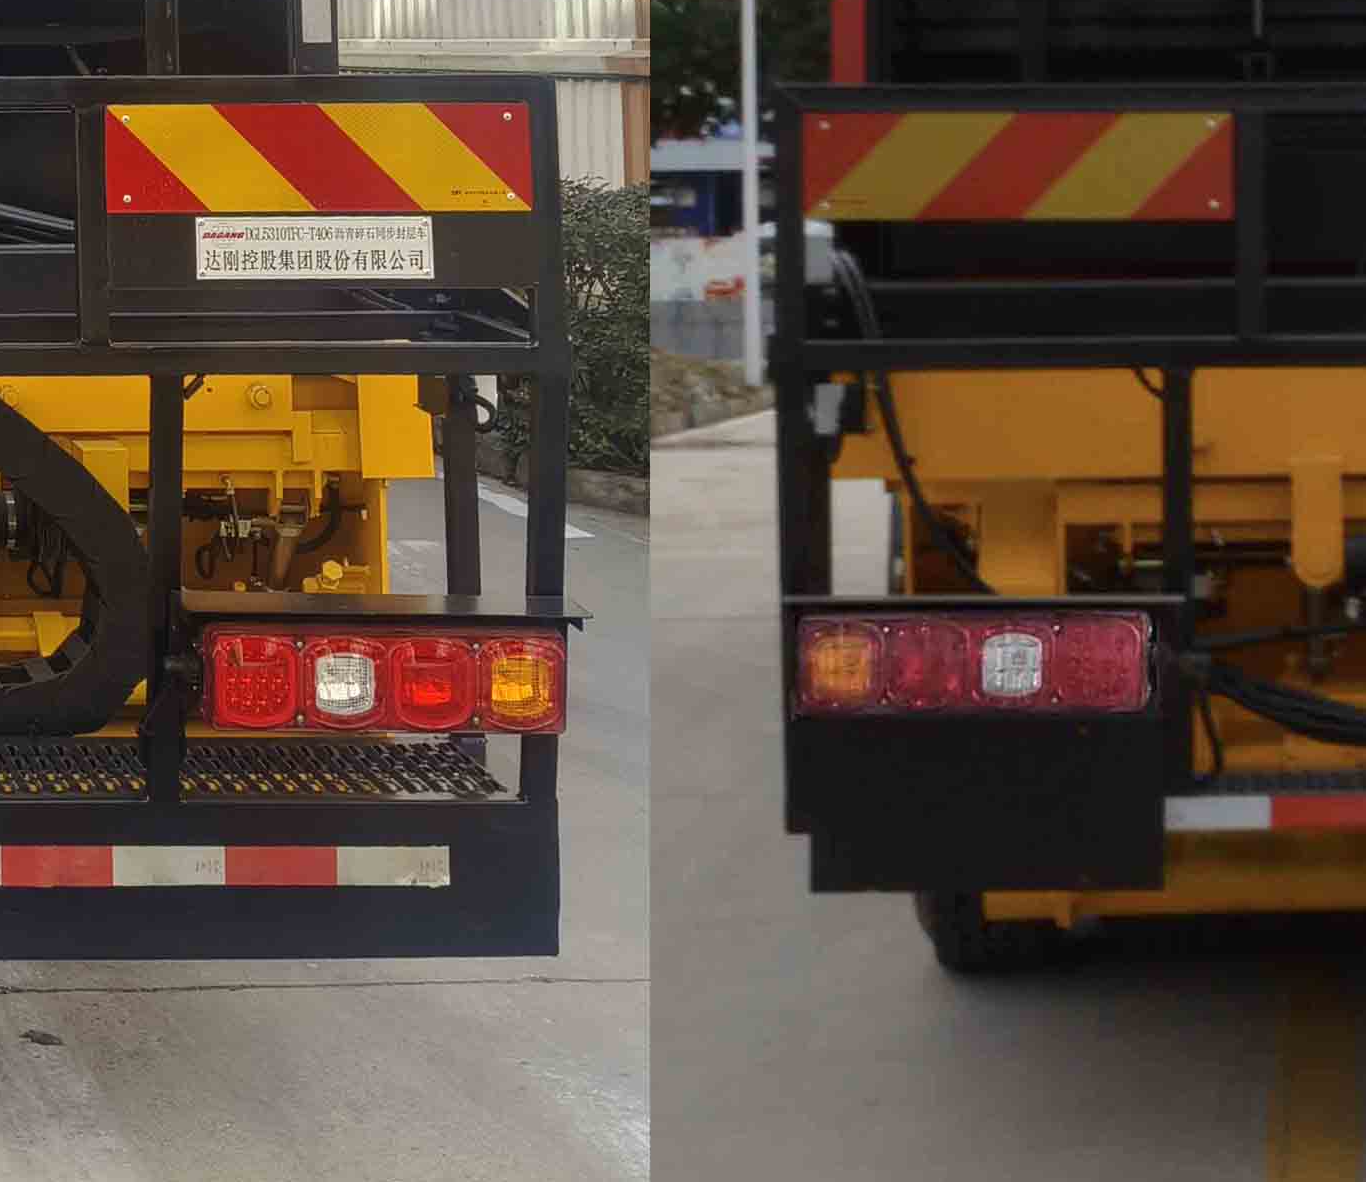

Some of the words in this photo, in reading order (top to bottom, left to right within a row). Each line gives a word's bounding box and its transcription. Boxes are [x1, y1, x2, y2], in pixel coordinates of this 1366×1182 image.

[205, 248, 425, 271] 达刚控股集团股份有限公司
